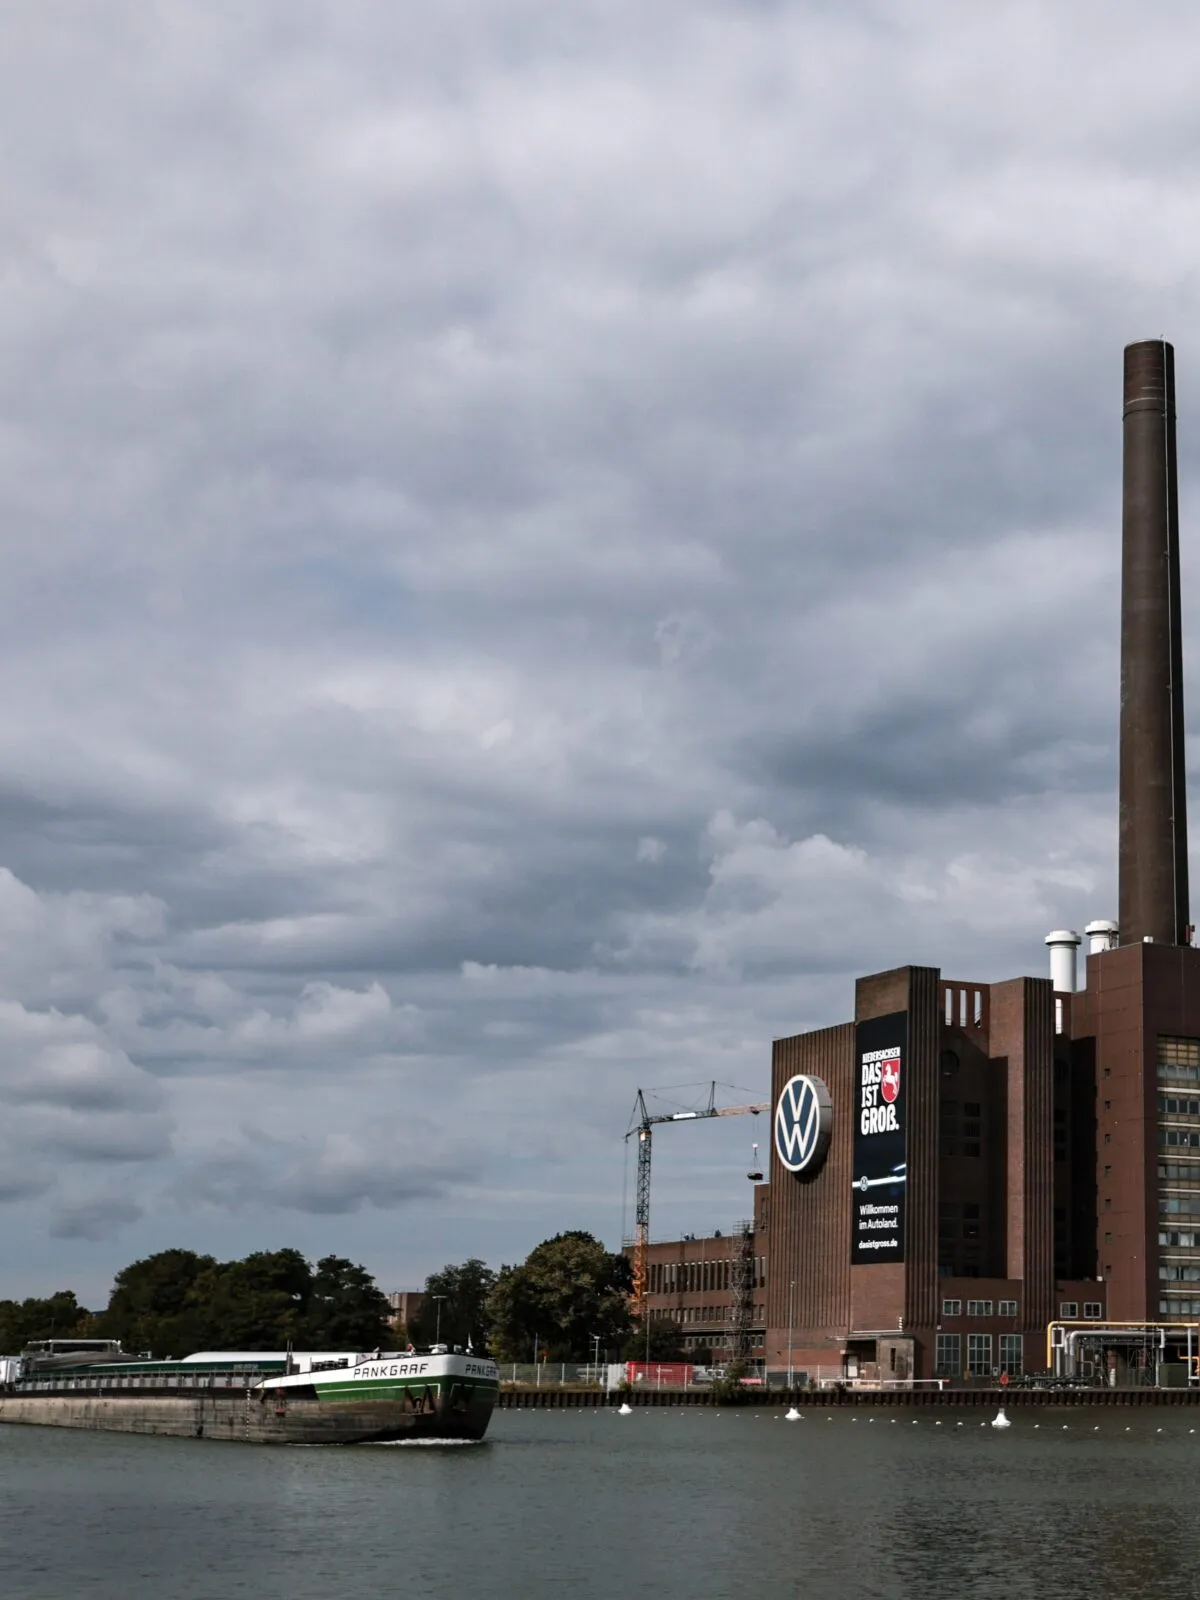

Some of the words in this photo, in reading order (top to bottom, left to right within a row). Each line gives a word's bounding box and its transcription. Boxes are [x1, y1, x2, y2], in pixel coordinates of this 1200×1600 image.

[861, 1061, 882, 1086] DAS
[861, 1084, 879, 1108] IST
[859, 1204, 899, 1215] Willkommen
[859, 1219, 867, 1230] im
[867, 1217, 899, 1229] Autoland.
[858, 1238, 898, 1250] dasistgross.de
[353, 1363, 429, 1379] PANKGRAF
